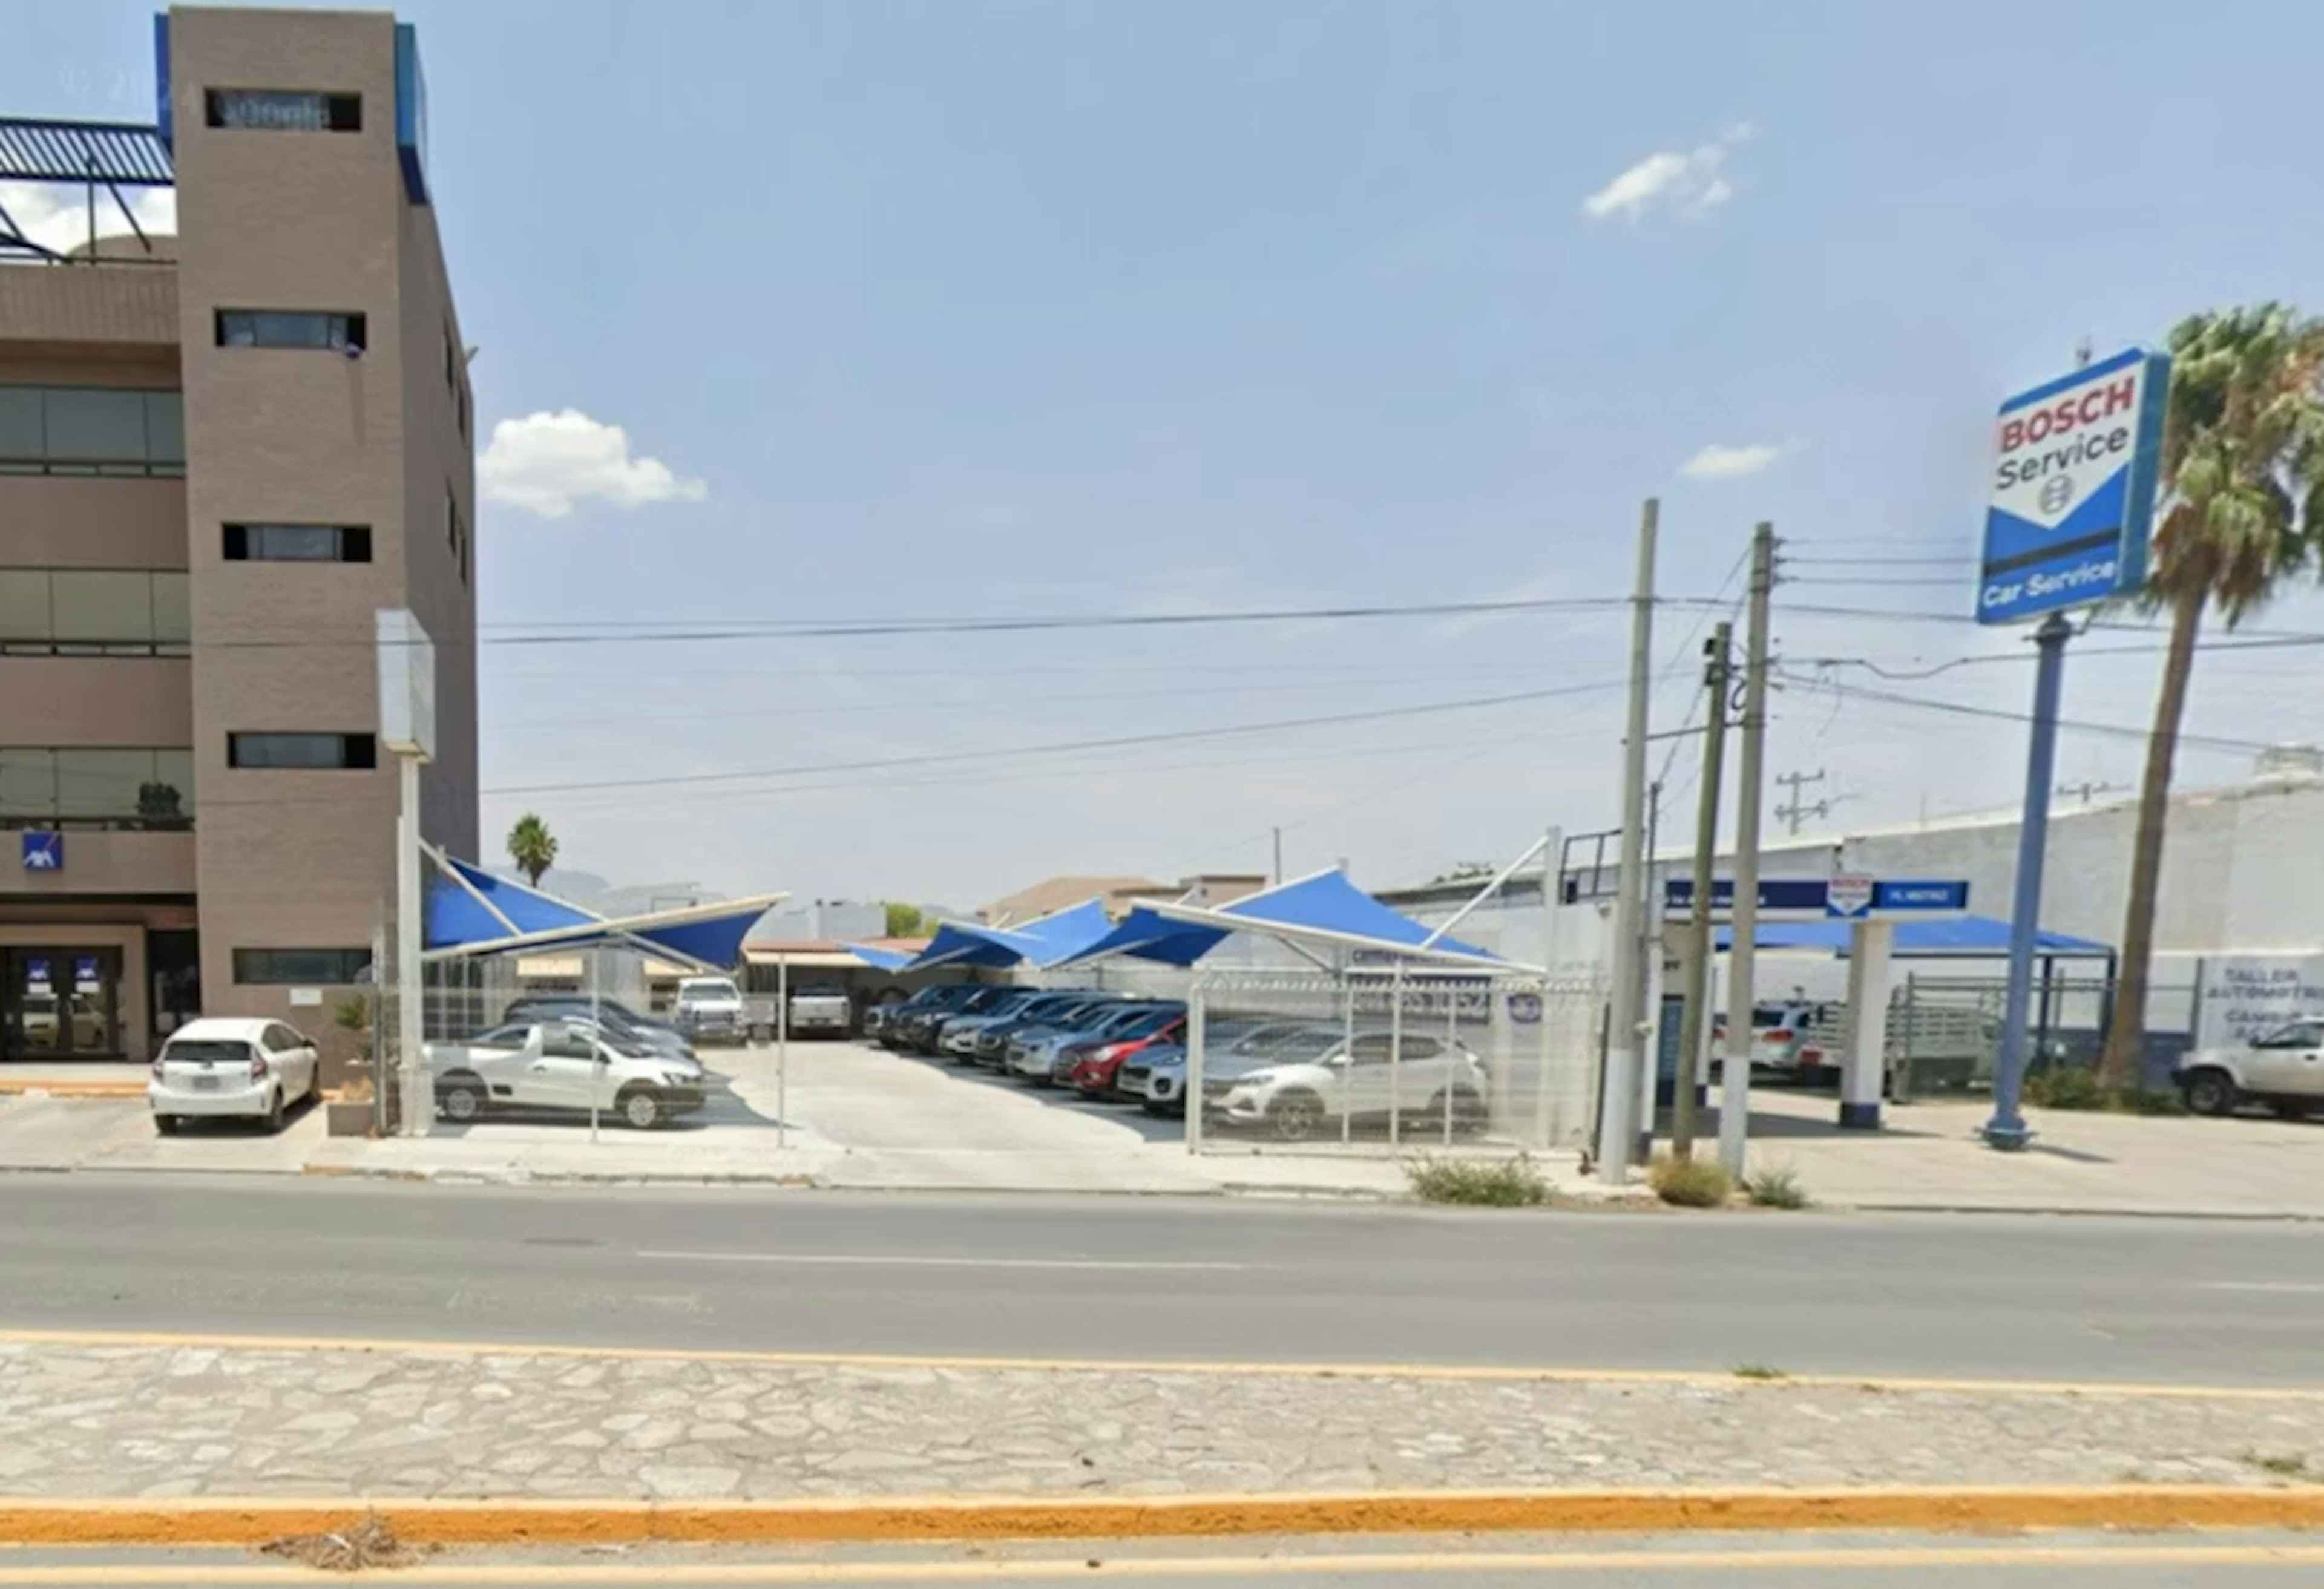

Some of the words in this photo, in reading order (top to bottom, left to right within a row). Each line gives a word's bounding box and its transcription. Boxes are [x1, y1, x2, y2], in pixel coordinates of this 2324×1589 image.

[2000, 376, 2136, 453] BOSCH
[1996, 425, 2129, 490] Service
[1983, 583, 2023, 606] Car
[2025, 559, 2118, 597] Service
